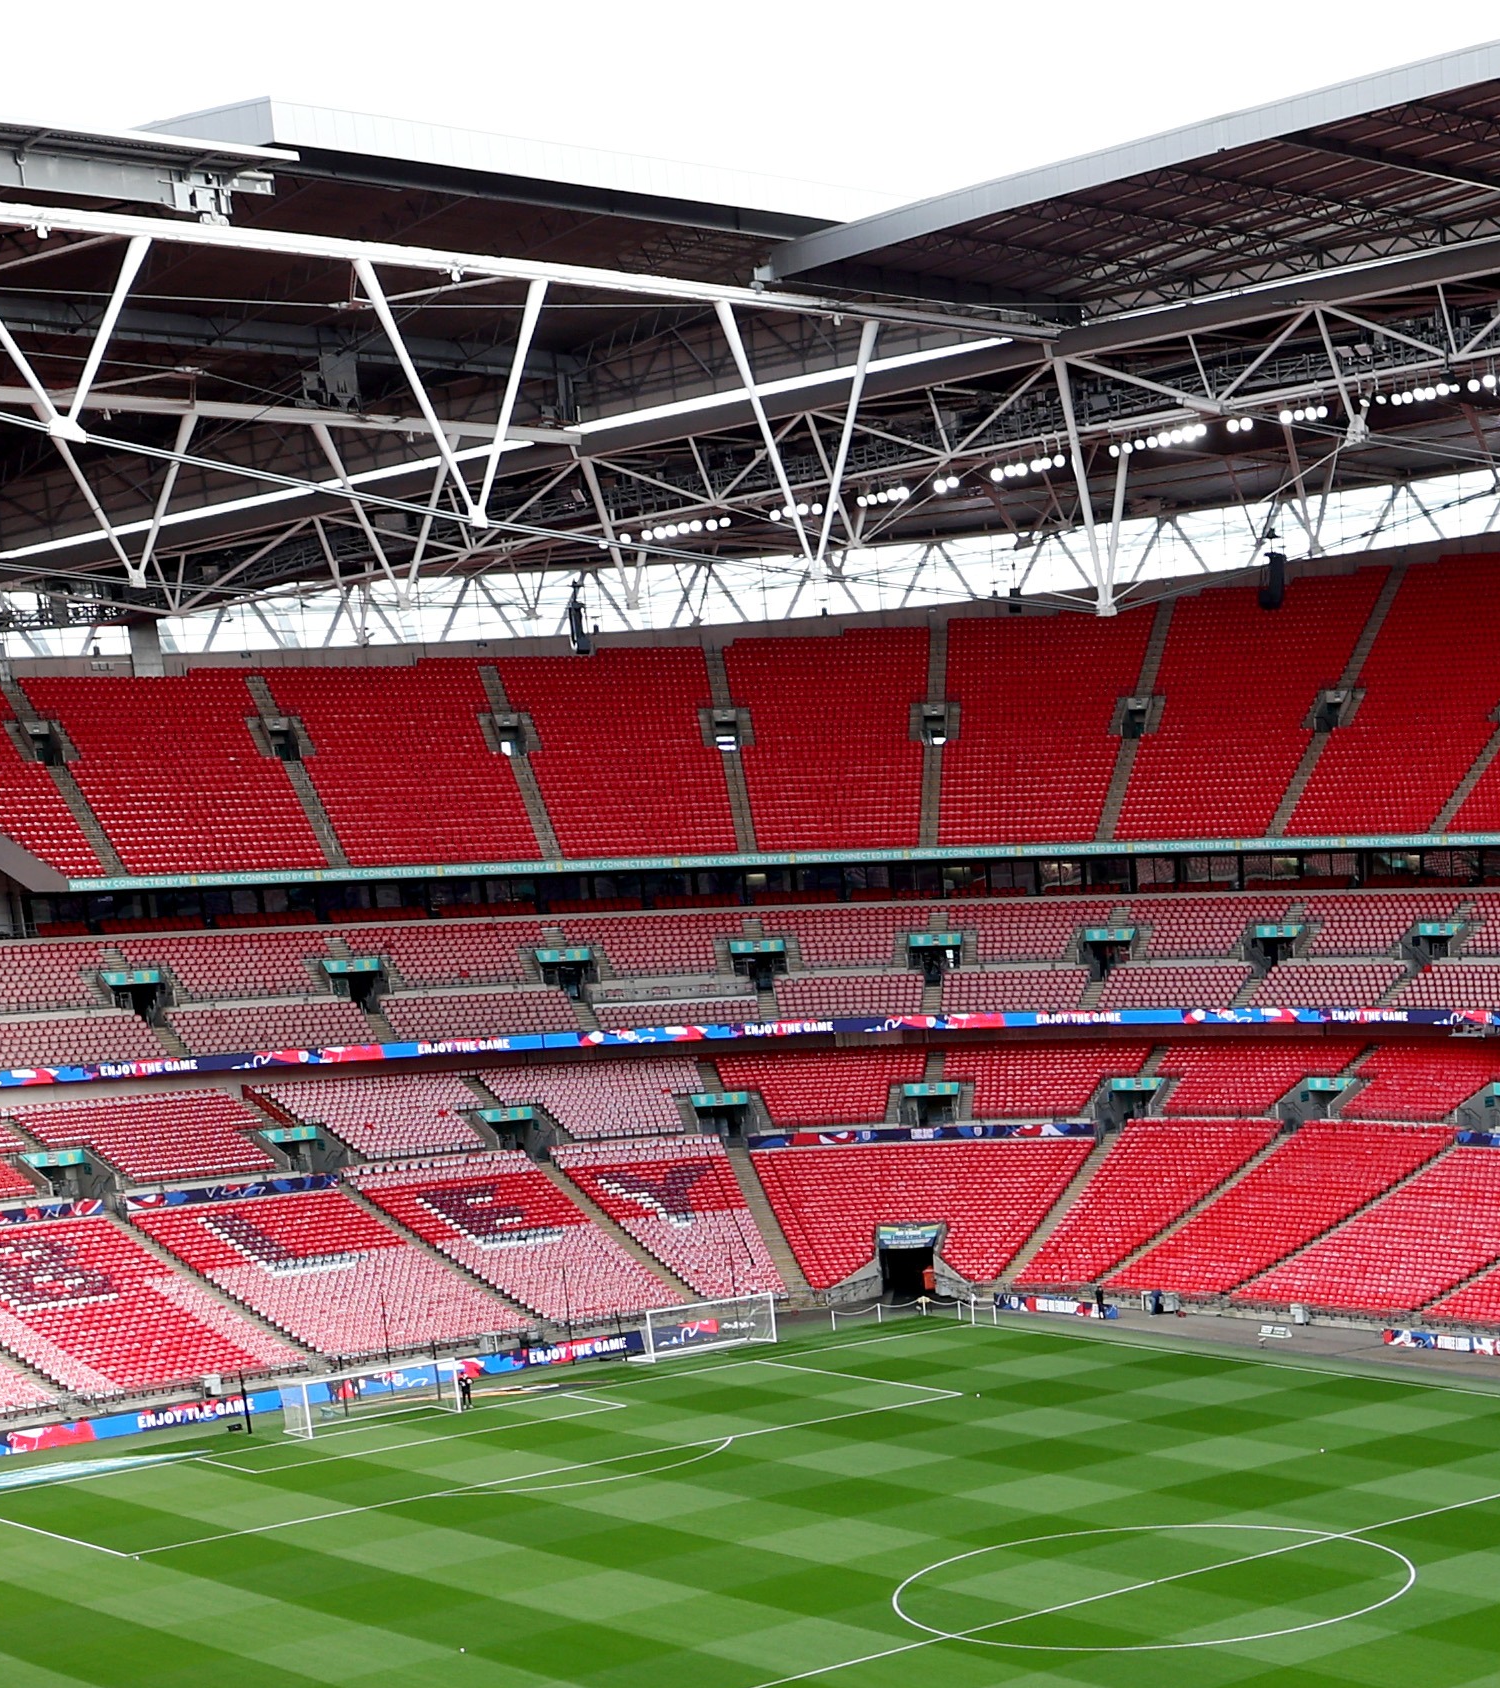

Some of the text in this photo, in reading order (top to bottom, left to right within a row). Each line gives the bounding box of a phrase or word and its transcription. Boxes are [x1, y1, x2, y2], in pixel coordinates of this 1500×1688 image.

[1036, 1012, 1121, 1024] ENJOY THE GAME
[1332, 1011, 1408, 1021] ENJOY THE GAME
[744, 1022, 833, 1035] ENJOY THE GAME
[418, 1039, 510, 1054] ENJOY THE GAME
[100, 1060, 197, 1076] ENJOY THE GAME
[529, 1347, 566, 1363] ENJOY
[138, 1410, 183, 1428] ENJOY
[215, 1398, 254, 1415] GAME
